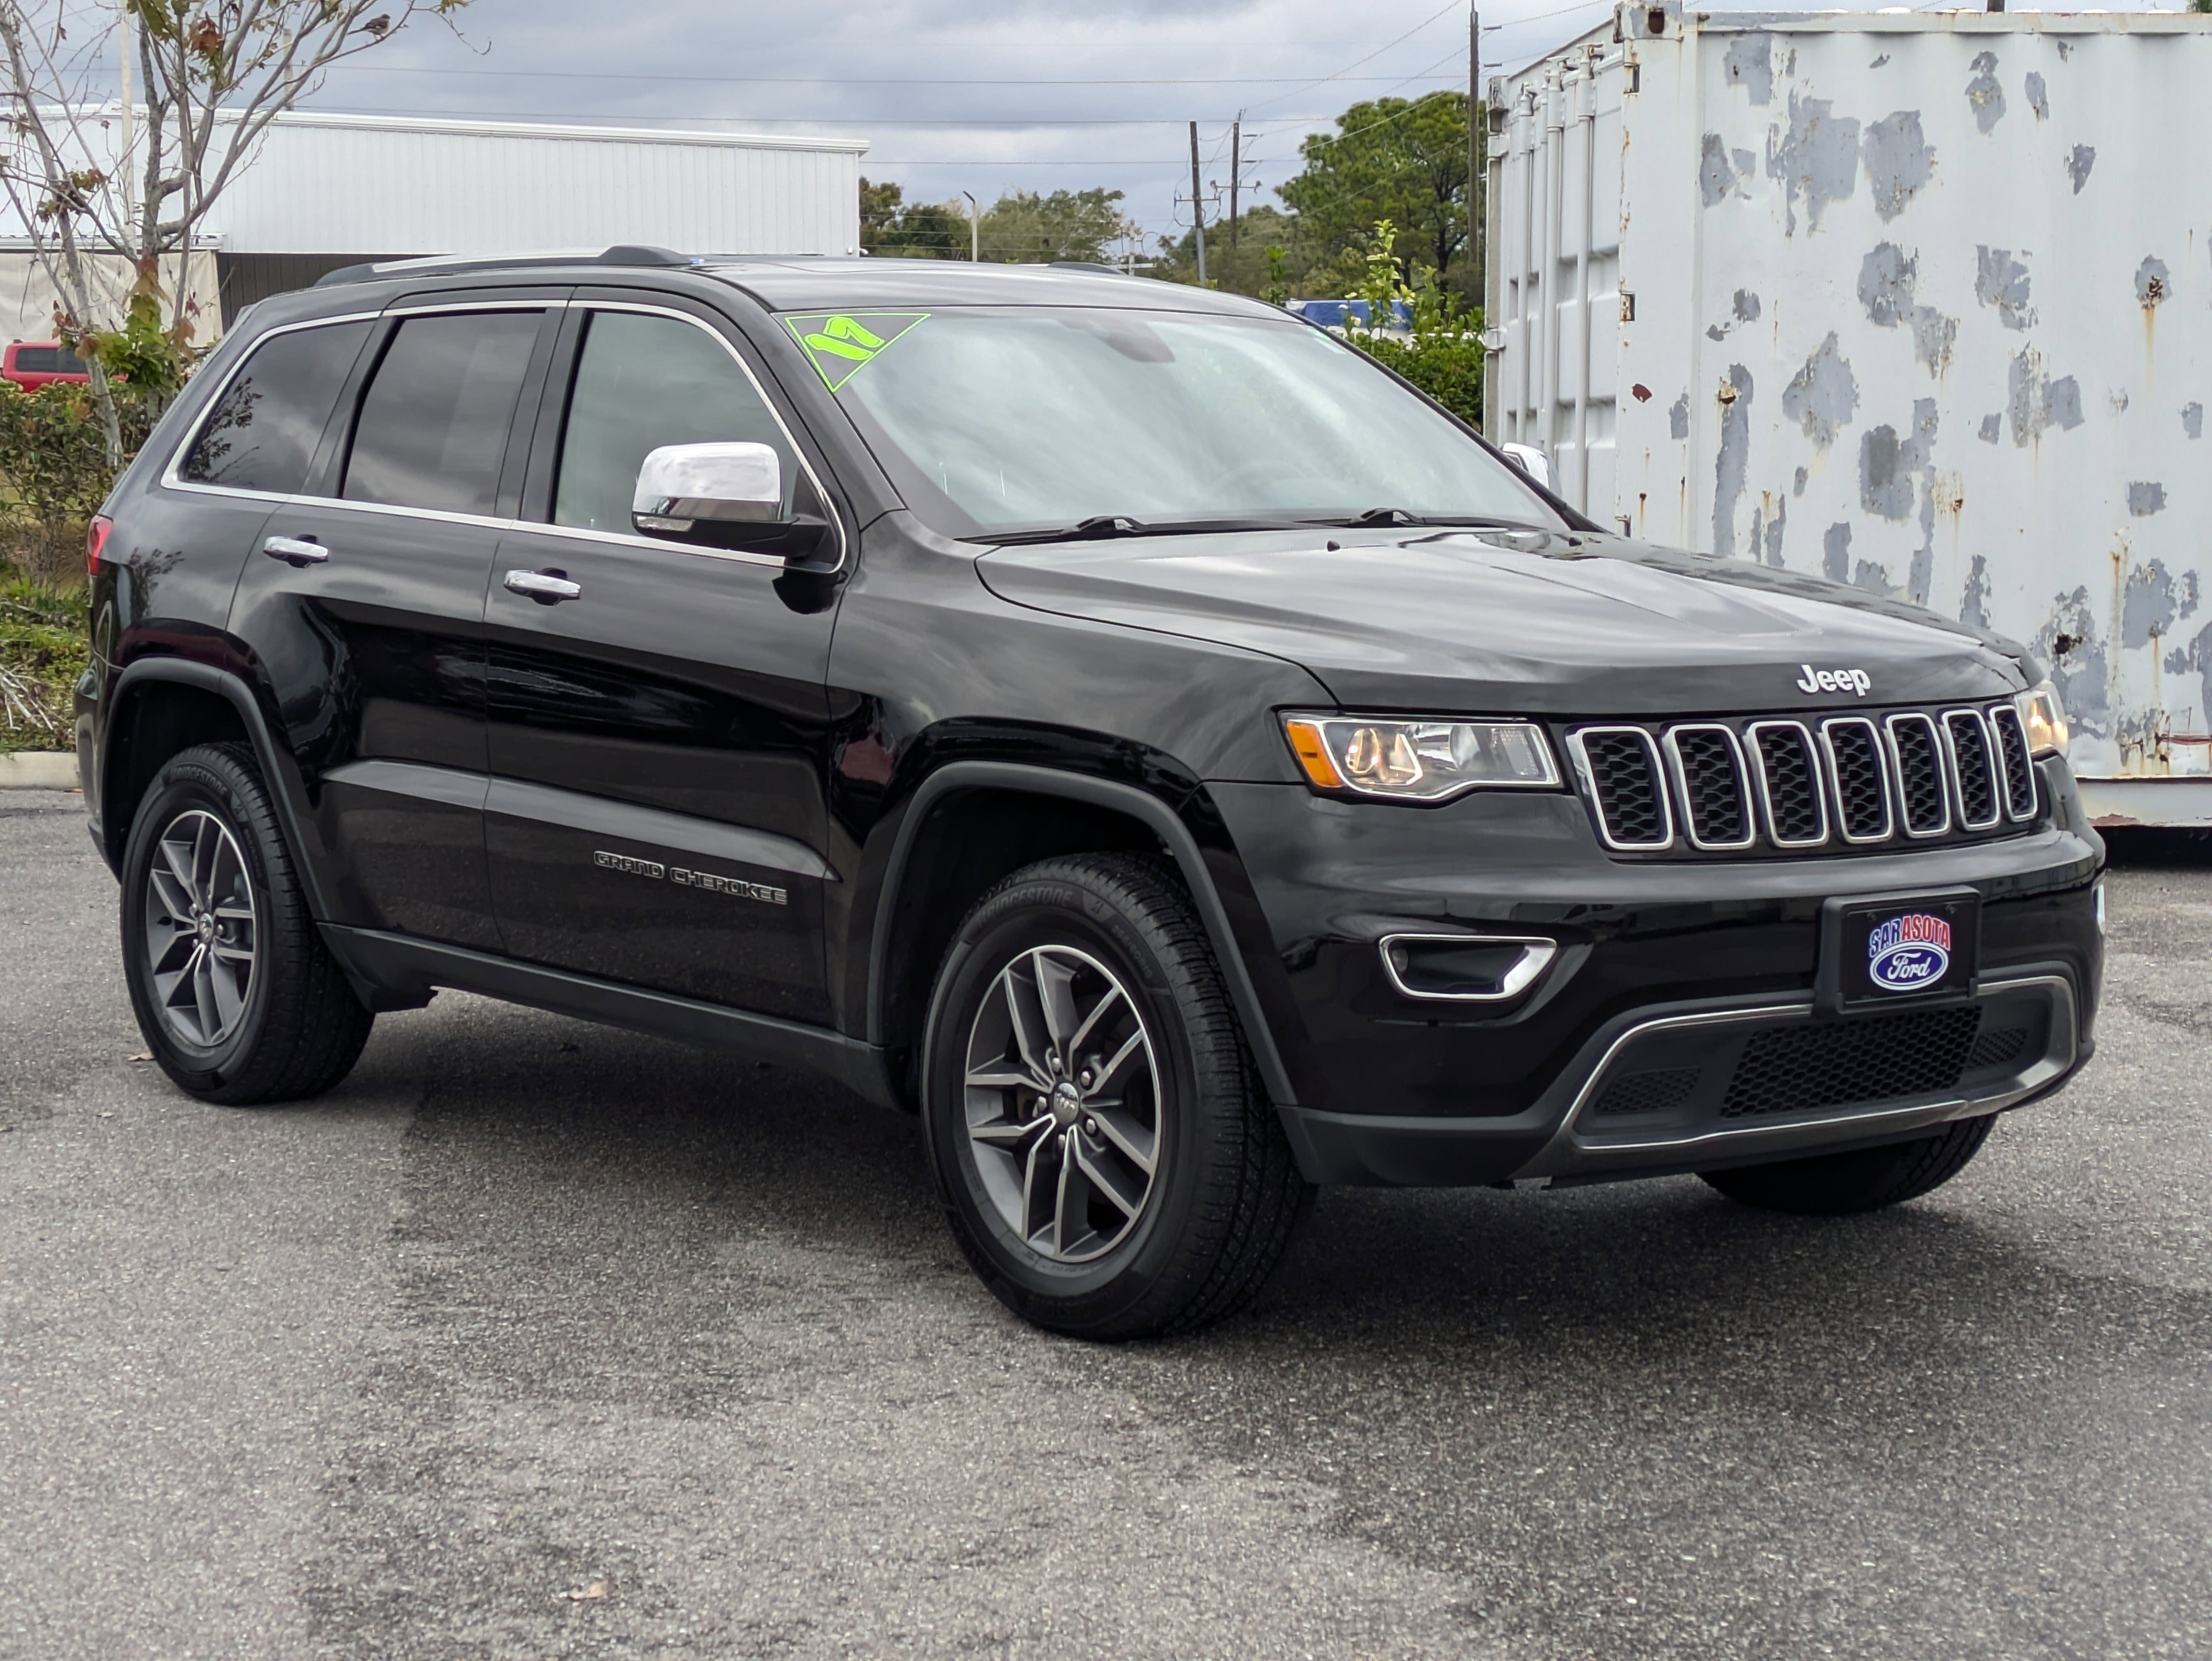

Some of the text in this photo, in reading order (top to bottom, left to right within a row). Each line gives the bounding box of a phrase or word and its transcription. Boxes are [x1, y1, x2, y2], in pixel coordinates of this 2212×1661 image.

[805, 316, 885, 361] 17
[1796, 664, 1871, 697] Jeep
[593, 851, 787, 905] GRAND CHEROKEE
[977, 886, 1073, 927] BRIDGESTONE
[1869, 914, 1951, 958] SARASOTA
[1887, 952, 1932, 979] Ford
